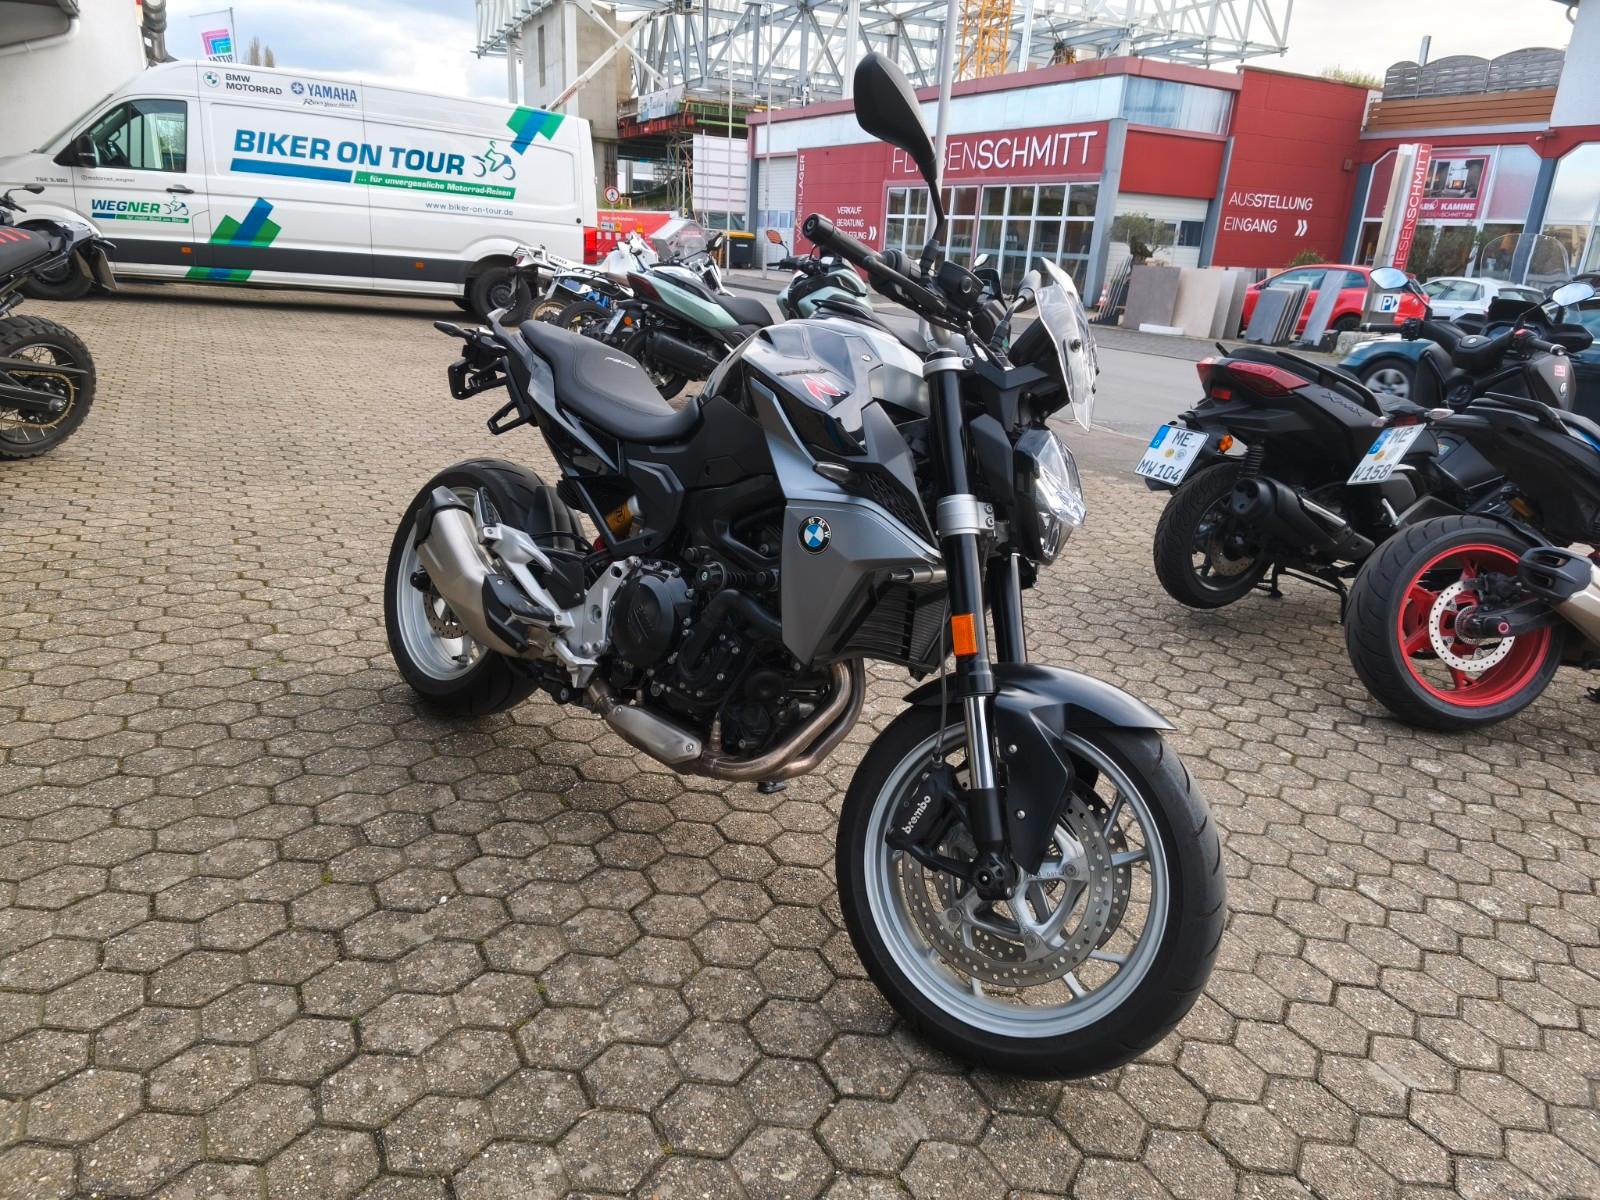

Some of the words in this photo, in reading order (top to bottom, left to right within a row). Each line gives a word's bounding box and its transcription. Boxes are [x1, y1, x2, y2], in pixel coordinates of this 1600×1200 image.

[226, 73, 250, 83] BMW
[226, 82, 283, 95] MOTORRAD
[307, 83, 358, 102] YAMAHA
[234, 129, 331, 161] BIKER
[336, 141, 383, 167] ON
[389, 147, 465, 176] TOUR
[892, 131, 1098, 174] FLSENSCHMITT
[369, 175, 383, 184] für
[385, 177, 445, 190] unvergessliche
[447, 182, 512, 197] Motorrad-Reisen
[91, 199, 160, 214] WEGNER
[425, 201, 514, 216] www.biker-on-tour.de
[836, 206, 863, 214] VERKAUF
[1229, 192, 1313, 211] AUSSTELLUNG
[1440, 202, 1476, 211] KAMINE
[836, 219, 864, 227] BERATUNG
[1223, 216, 1278, 233] EINGANG
[1382, 297, 1392, 310] P
[1171, 430, 1193, 447] ME
[1388, 427, 1414, 444] ME
[1137, 459, 1158, 475] MW
[1154, 464, 1184, 482] 104
[1361, 464, 1393, 480] 158
[808, 517, 831, 539] BMW
[901, 795, 931, 835] brembo
